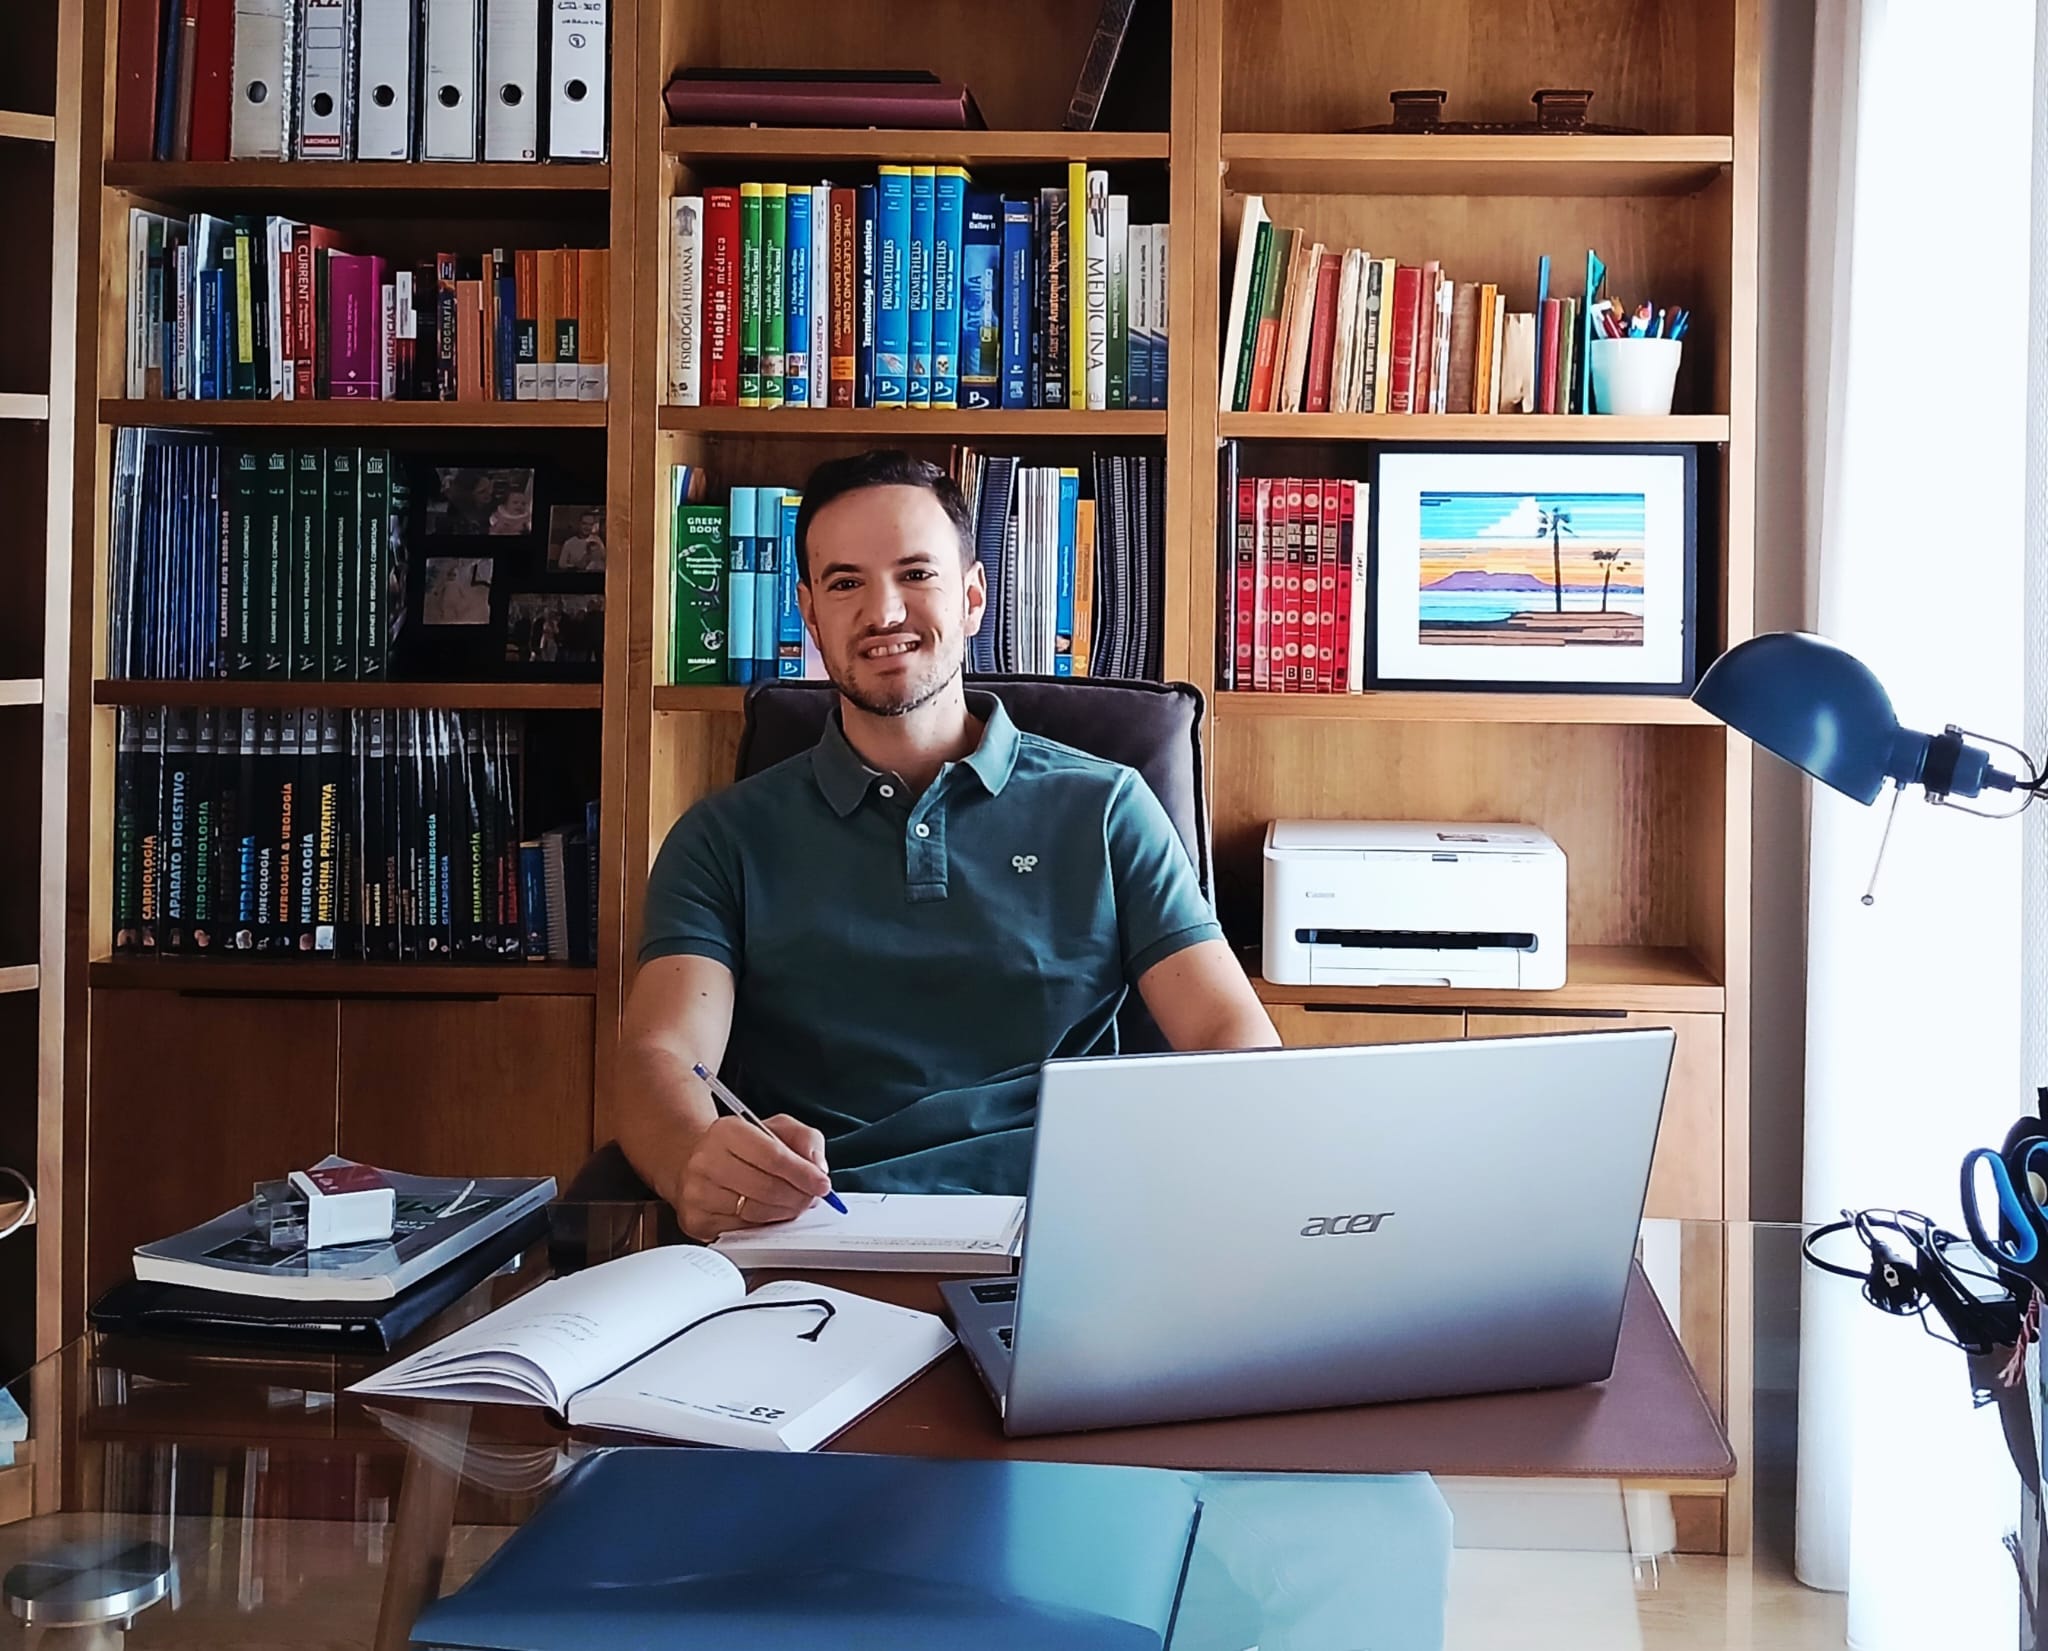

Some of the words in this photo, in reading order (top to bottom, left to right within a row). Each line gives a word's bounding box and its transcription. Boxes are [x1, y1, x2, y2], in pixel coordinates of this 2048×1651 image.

[834, 203, 843, 269] CARDIOLOGY
[844, 217, 852, 238] THE
[862, 219, 874, 275] Anatómica
[1048, 230, 1060, 272] Humana
[298, 244, 310, 301] CURRENT
[680, 246, 693, 301] HUMANA
[713, 237, 727, 284] médica
[834, 271, 843, 307] BOARD
[844, 240, 852, 298] CLEVELAND
[883, 239, 894, 310] PROMETHEUS
[911, 239, 922, 310] PROMETHEUS
[936, 239, 947, 310] PROMETHEUS
[713, 290, 727, 360] Fisiología
[844, 300, 852, 334] CLINIC
[862, 279, 874, 347] Terminología
[1048, 274, 1060, 321] Anatomía
[1087, 257, 1105, 370] MEDICINA
[386, 305, 396, 372] URGENCIAS
[834, 310, 843, 349] REVIEW
[687, 517, 721, 525] GREEN
[169, 771, 184, 848] DIGESTIVO
[279, 782, 292, 839] UROLOGÍA
[318, 783, 332, 857] PREVENTIVA
[141, 835, 154, 920] CARDIOLOGÍA
[169, 852, 184, 919] APARATO
[237, 835, 255, 921] PEDIATRÍA
[299, 833, 313, 924] NEUROLOGÍA
[318, 860, 332, 922] MEDICINA
[1300, 1211, 1395, 1237] acer
[748, 1405, 785, 1419] 23
